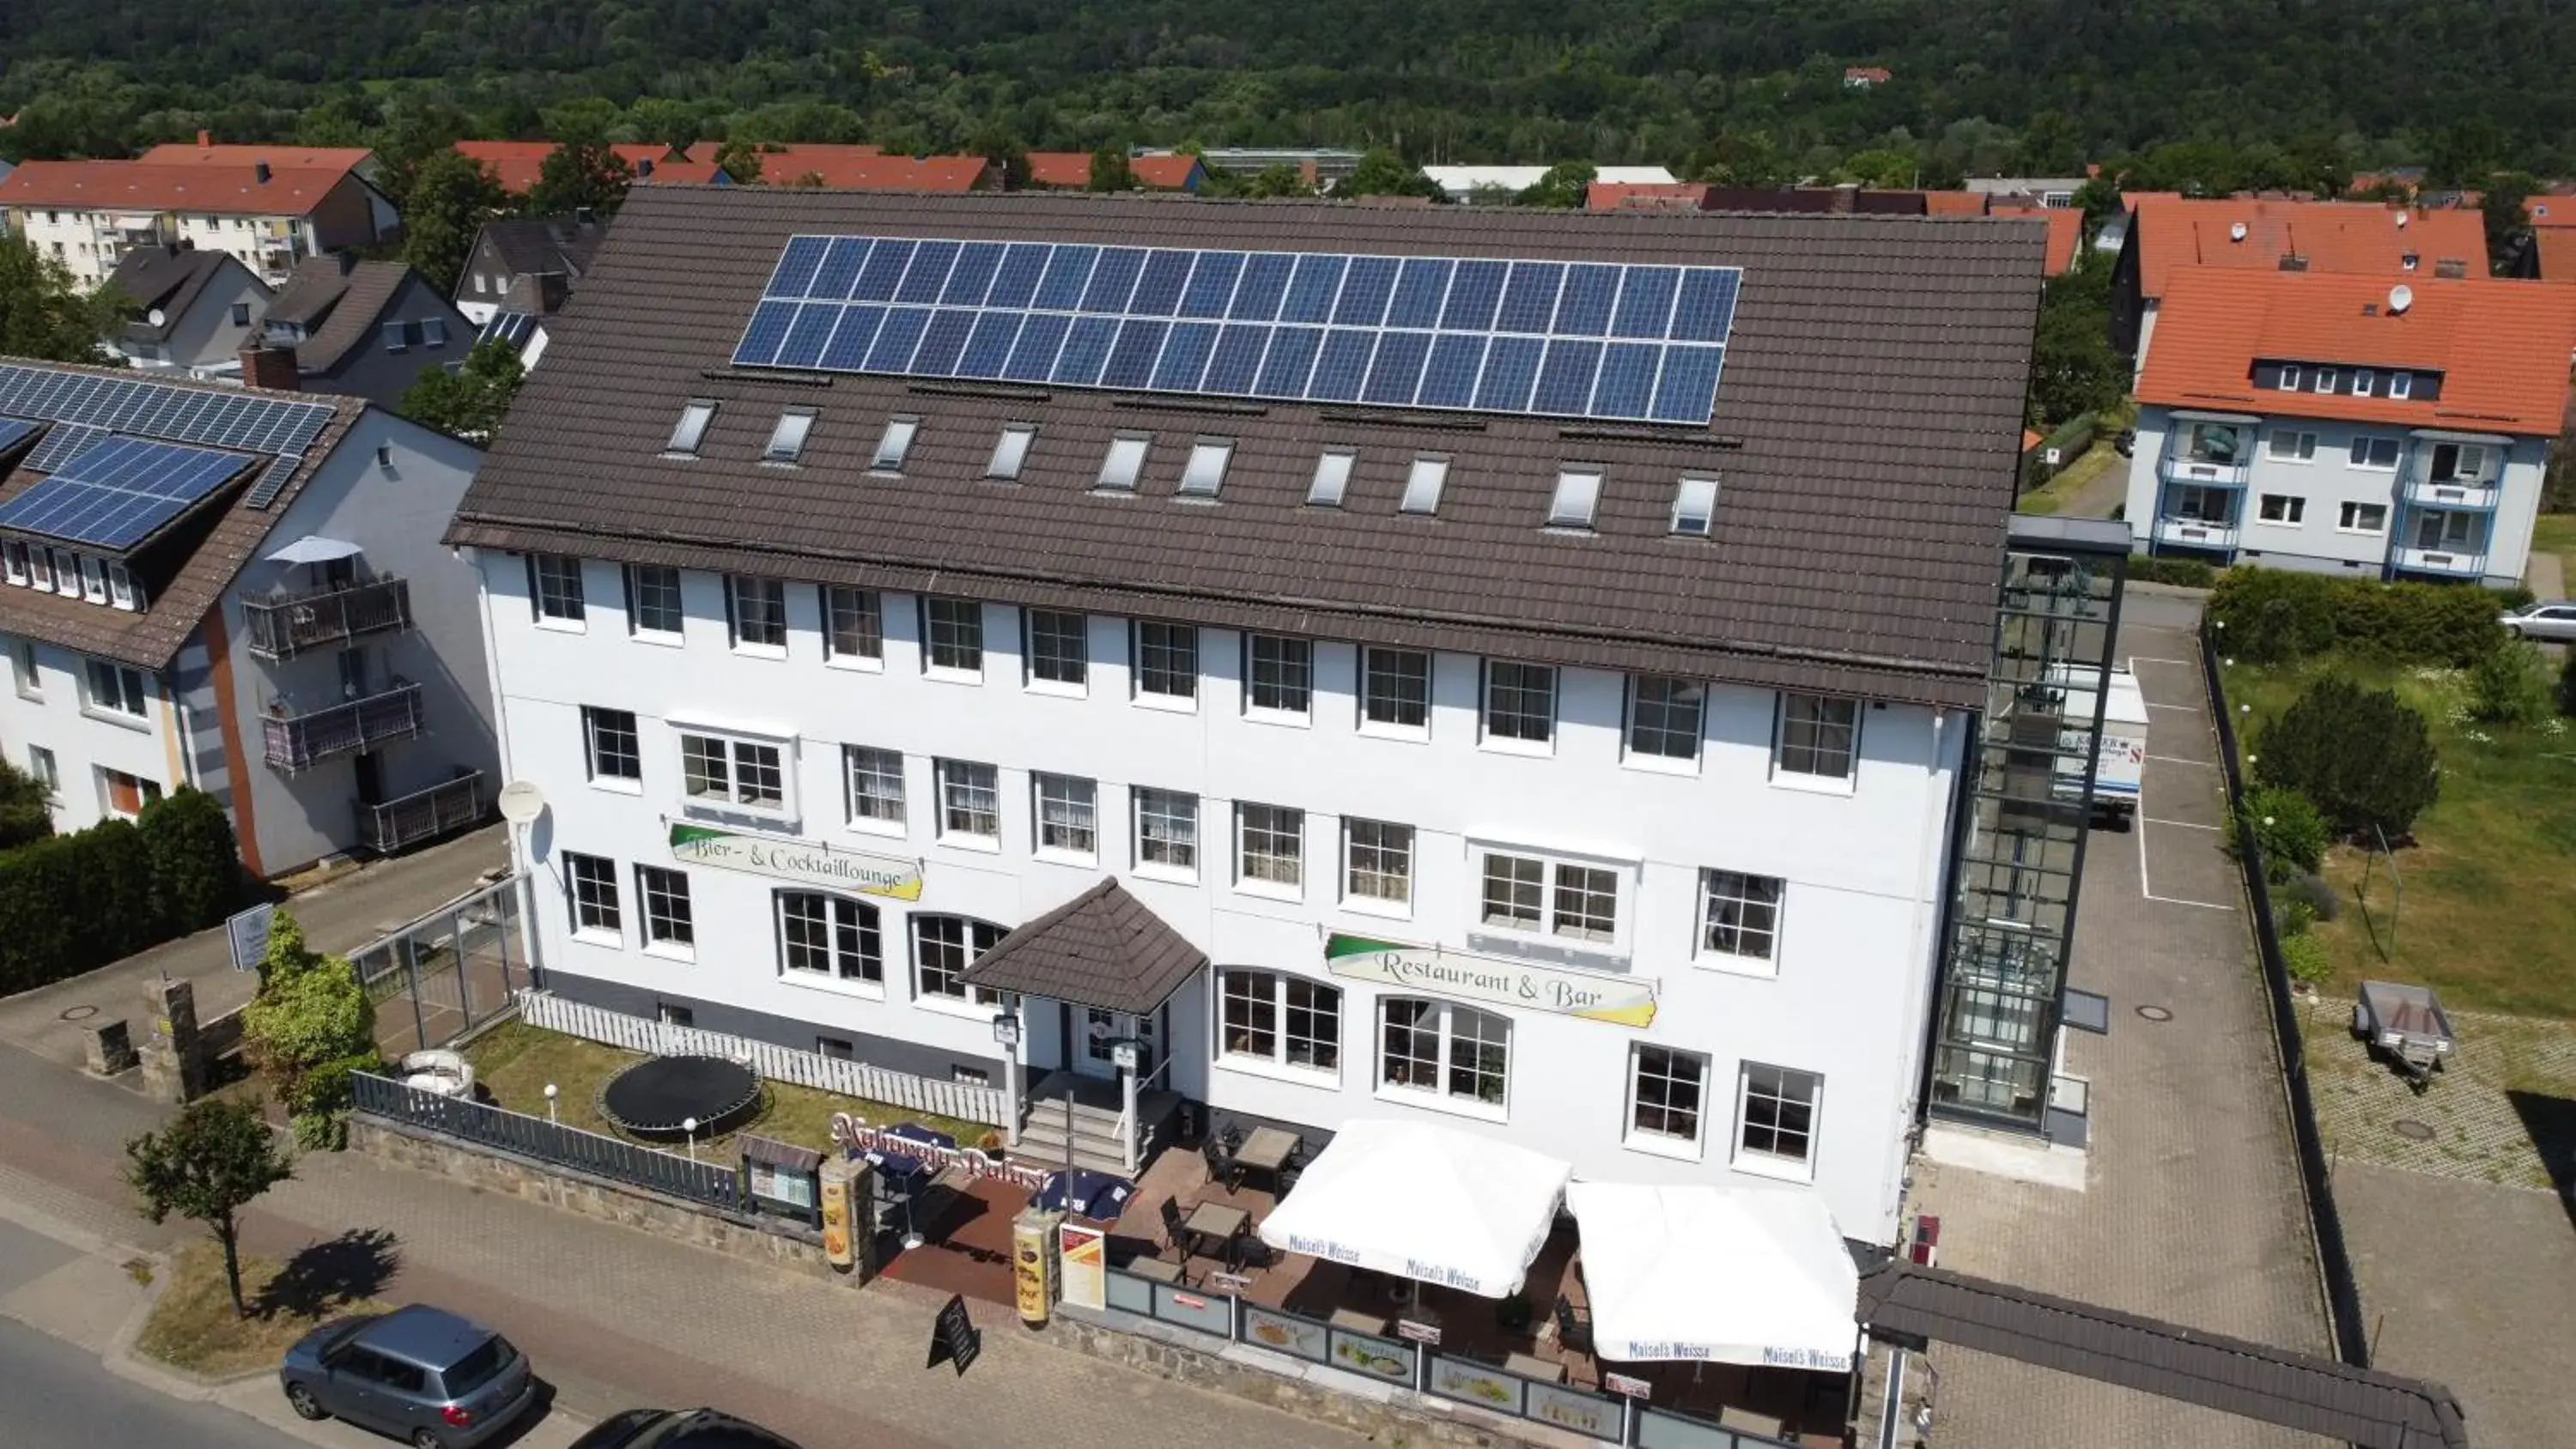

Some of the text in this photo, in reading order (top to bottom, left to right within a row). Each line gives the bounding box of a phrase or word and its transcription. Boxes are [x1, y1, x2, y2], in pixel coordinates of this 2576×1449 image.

[749, 844, 766, 866] &
[770, 848, 902, 892] Cocktaillounge
[1377, 953, 1602, 1008] Restaurant & Bar
[1327, 1241, 1361, 1264] Weisse
[1446, 1266, 1480, 1290] Weisse
[1673, 1341, 1710, 1359] Weisse
[1807, 1349, 1848, 1367] Weisse
